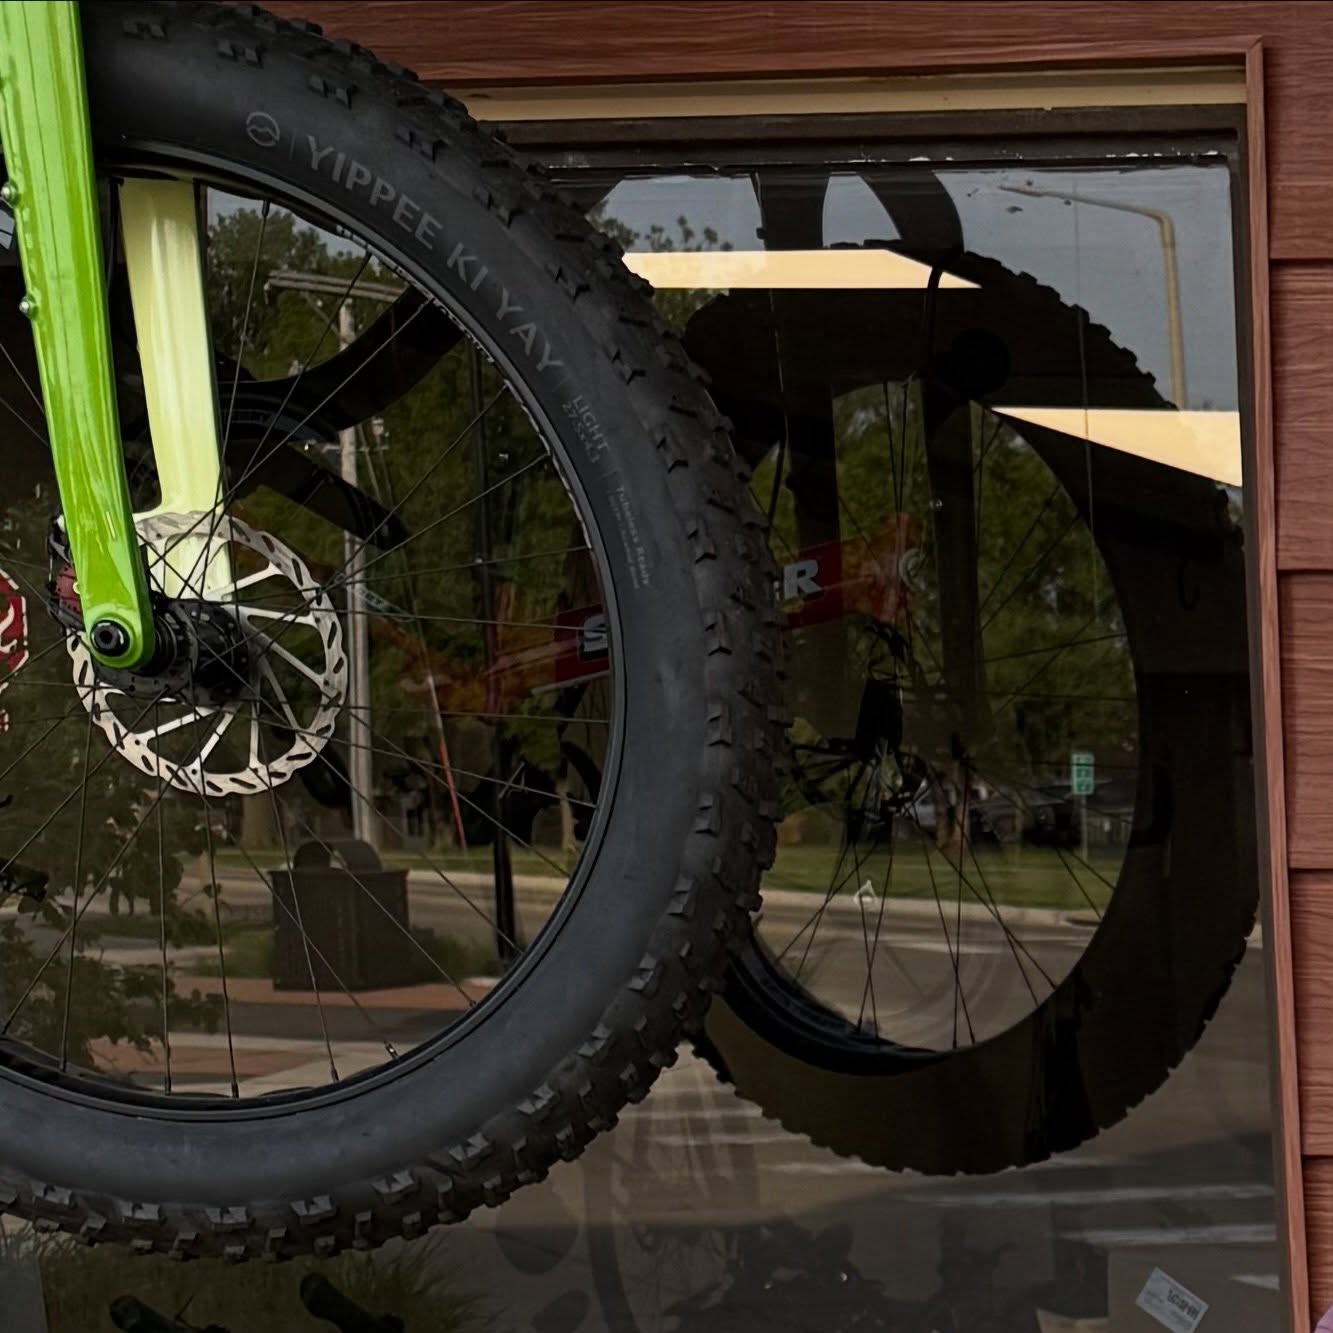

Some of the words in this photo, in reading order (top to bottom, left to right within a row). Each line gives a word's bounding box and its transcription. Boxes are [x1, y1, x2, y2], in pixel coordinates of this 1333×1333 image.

[307, 136, 444, 249] YIPPEE
[446, 242, 488, 291] KI
[572, 394, 609, 449] LIGHT
